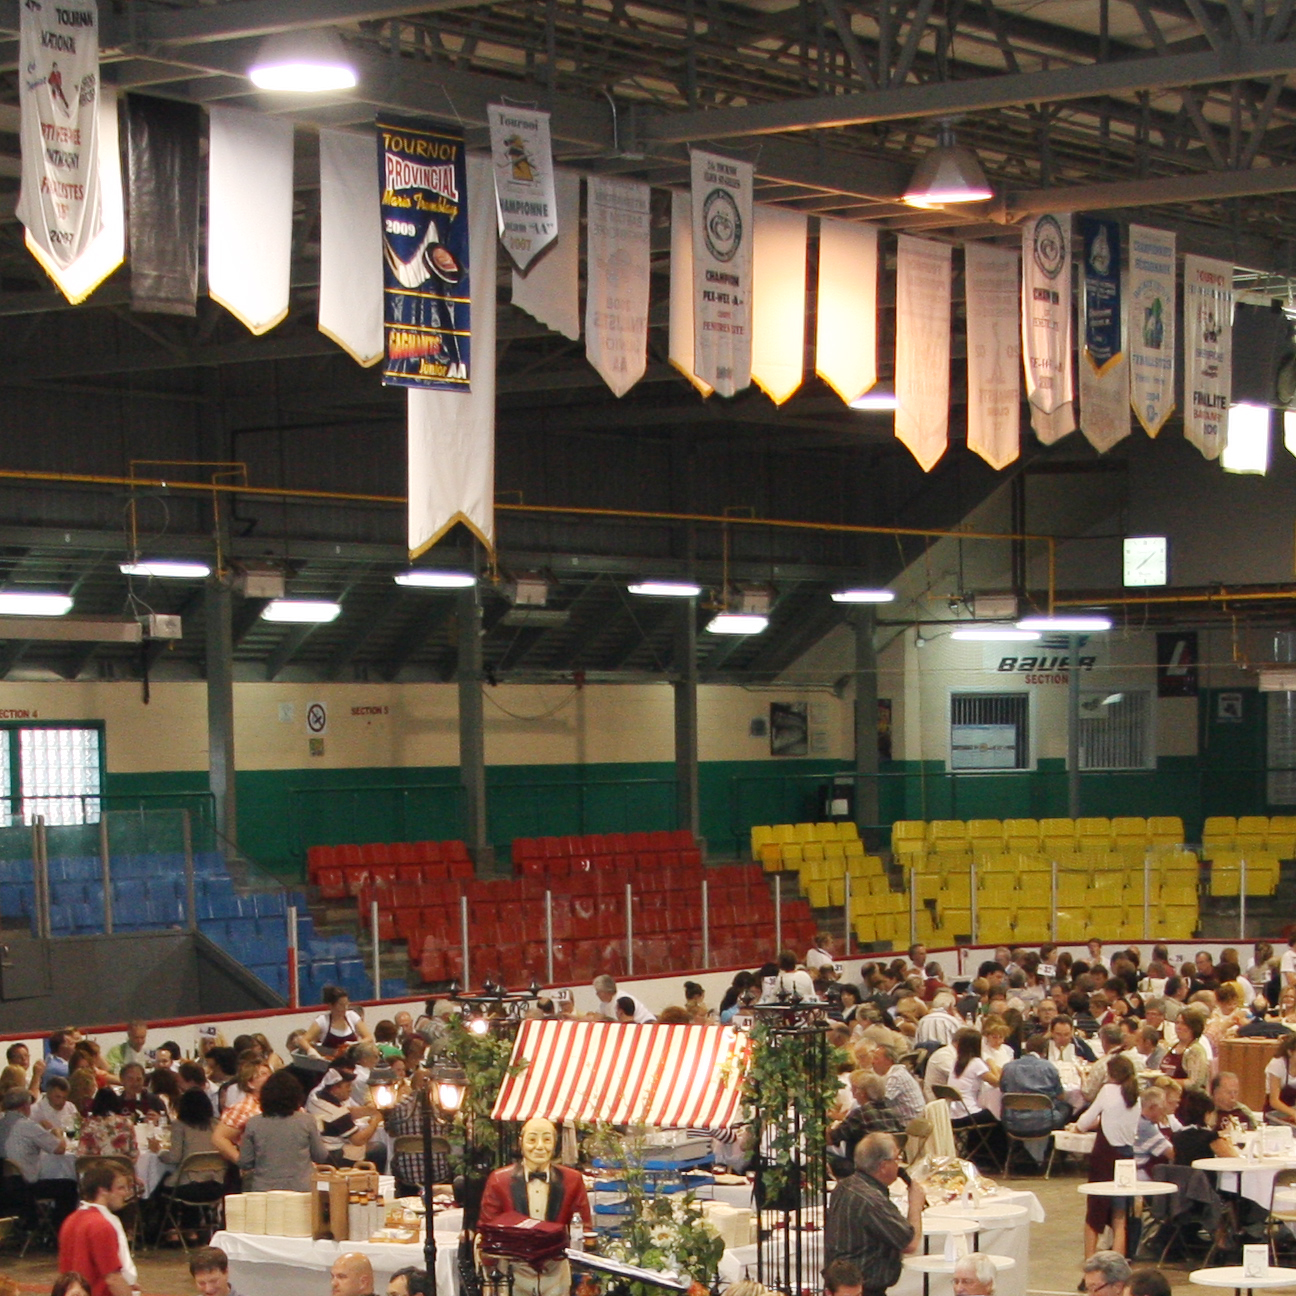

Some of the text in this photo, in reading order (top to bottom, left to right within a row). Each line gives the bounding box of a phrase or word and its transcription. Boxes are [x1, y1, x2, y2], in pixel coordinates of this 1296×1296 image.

[498, 112, 539, 131] Tournoi
[382, 133, 458, 162] TOURNOI
[385, 152, 459, 203] PROVINCIAL
[382, 188, 459, 223] Mario Tremblay
[499, 198, 549, 217] HAMPIONNE
[385, 219, 416, 238] 2009
[418, 358, 467, 380] Junior AA
[1025, 674, 1070, 685] SECTION
[29, 710, 38, 719] 4
[351, 706, 380, 716] SECTION
